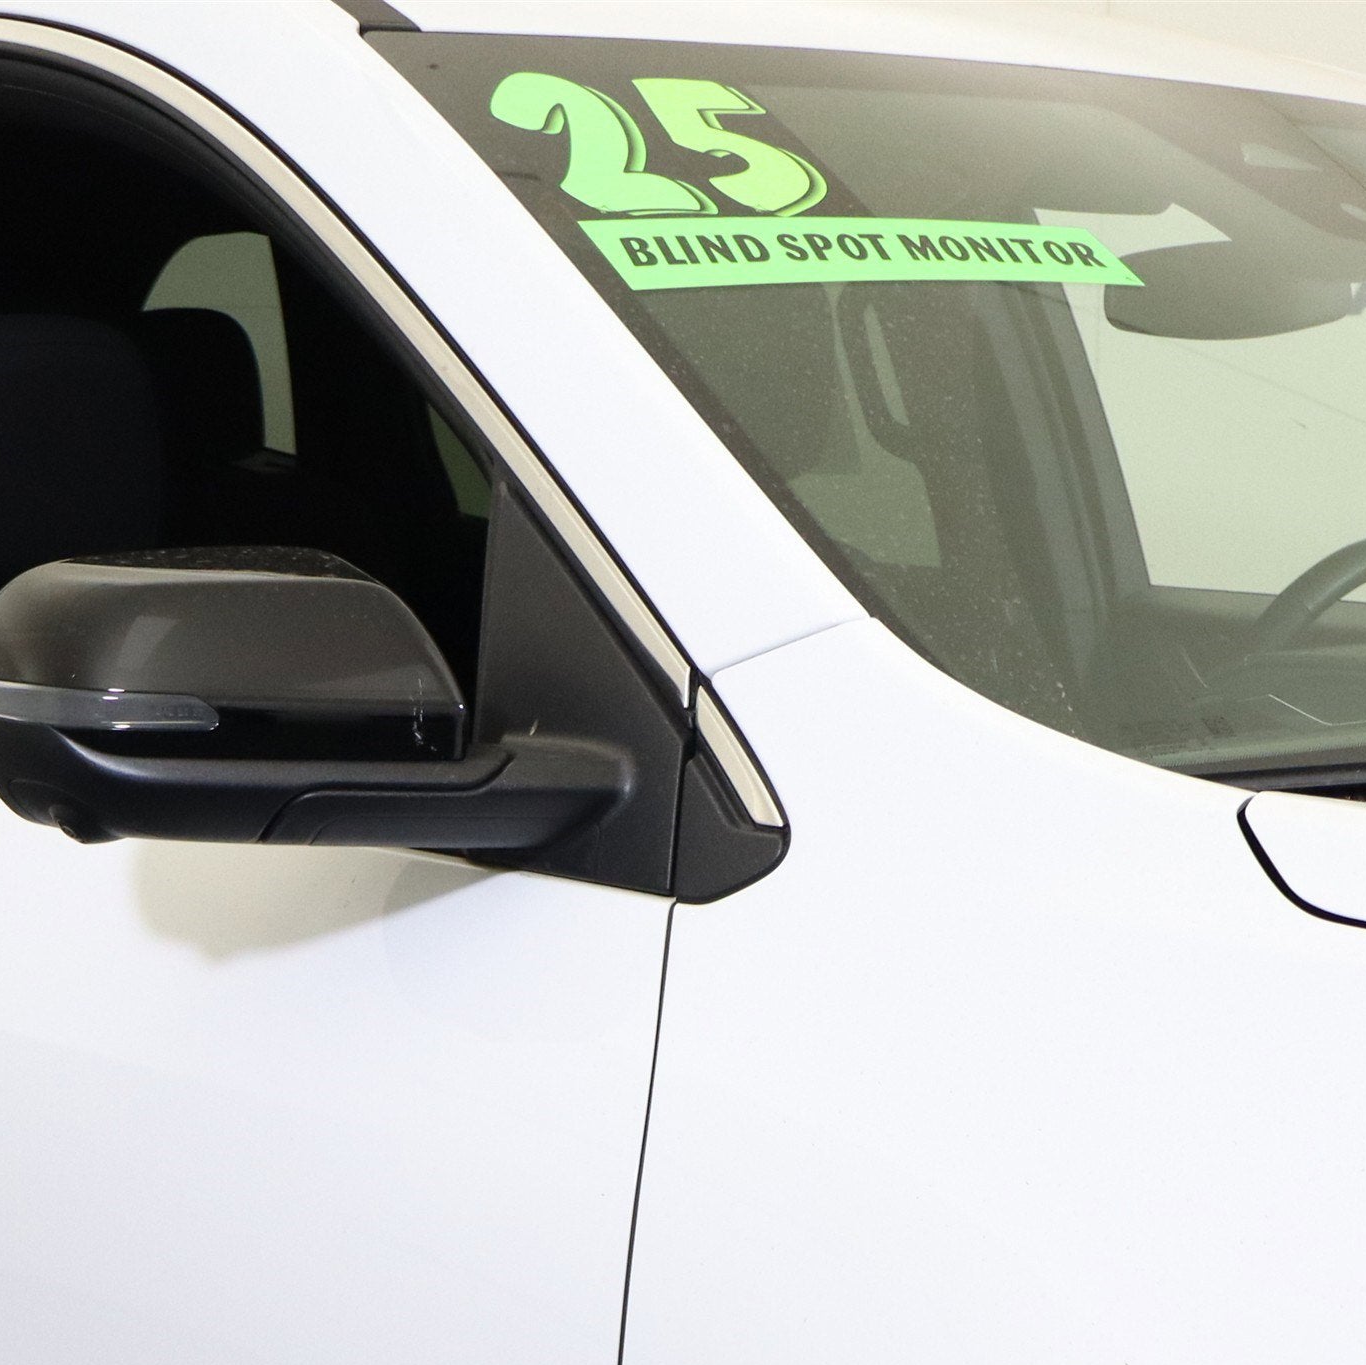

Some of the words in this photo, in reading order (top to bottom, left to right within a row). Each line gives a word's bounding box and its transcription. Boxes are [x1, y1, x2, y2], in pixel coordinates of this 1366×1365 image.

[490, 72, 828, 217] 25
[619, 234, 771, 266] BLIND
[776, 233, 892, 261] SPOT
[896, 234, 1108, 268] MONITOR
